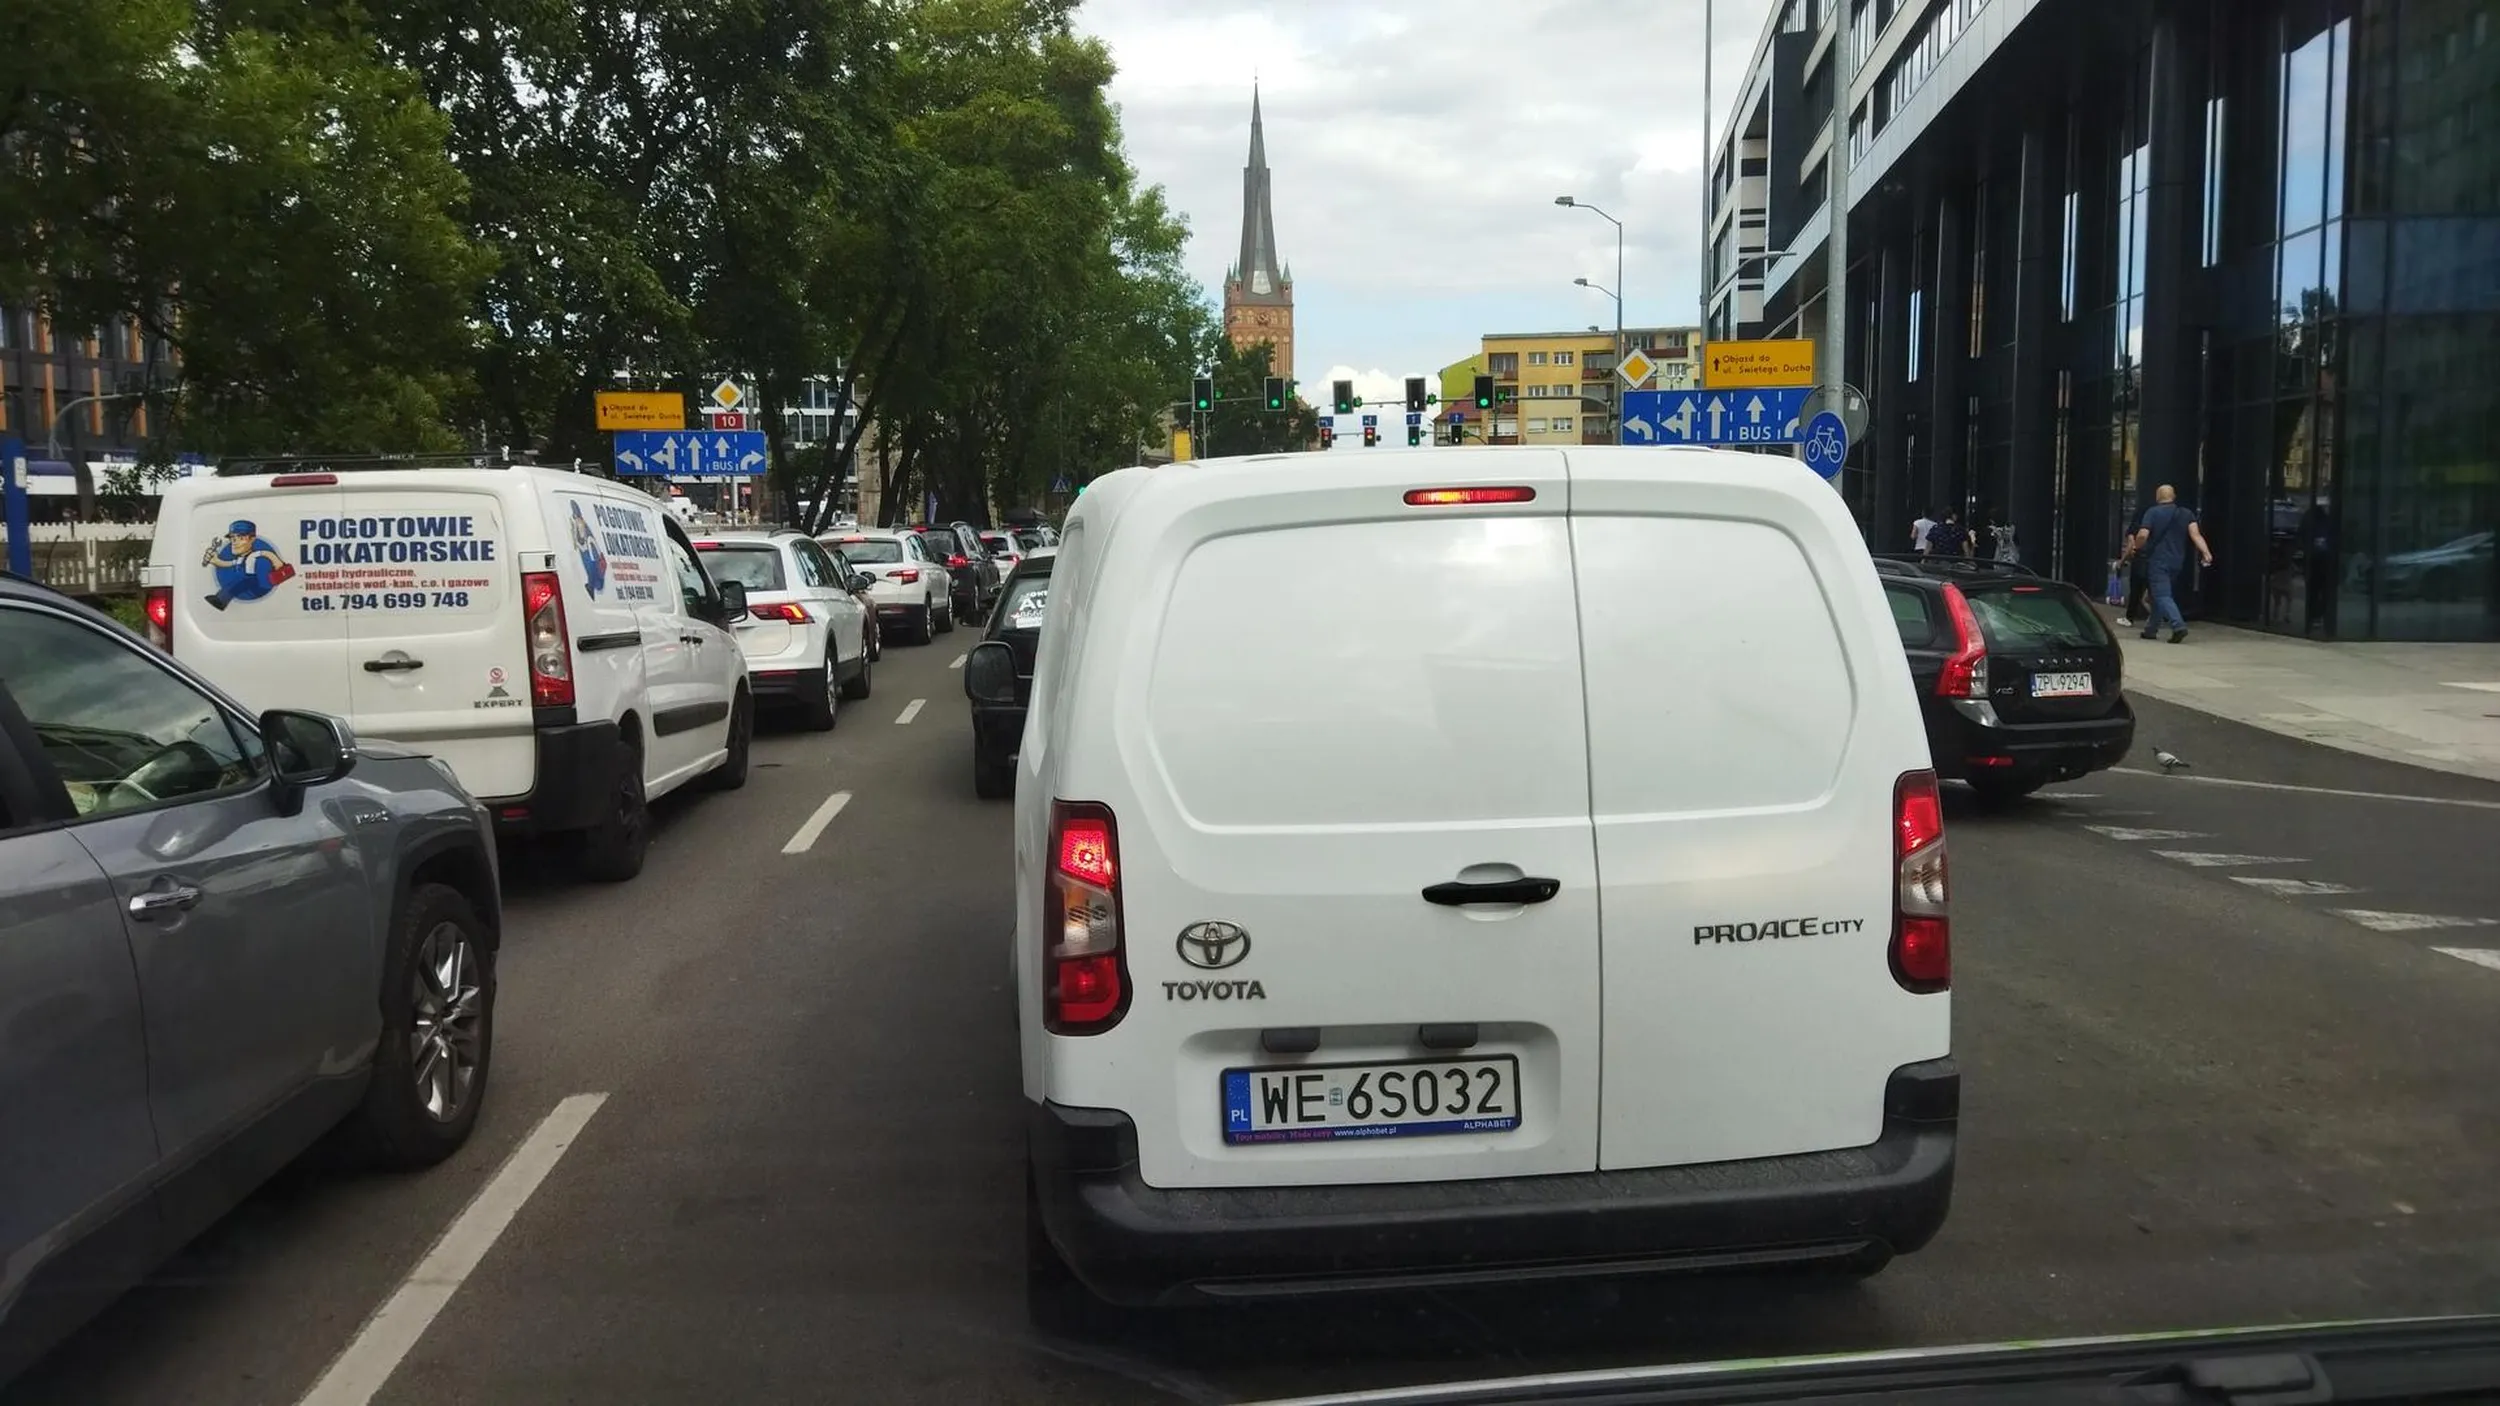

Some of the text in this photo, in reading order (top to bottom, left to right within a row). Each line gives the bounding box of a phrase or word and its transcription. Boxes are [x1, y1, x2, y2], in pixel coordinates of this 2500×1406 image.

[1759, 354, 1770, 362] do
[722, 415, 736, 427] 10
[1739, 426, 1771, 440] BUS
[713, 460, 734, 471] BUS
[300, 516, 473, 540] POGOTOWIE
[300, 540, 495, 565] LOKATORSKIE
[302, 592, 469, 611] tel. 794 699 748
[2037, 674, 2090, 691] ZPL 92947
[474, 699, 523, 708] EXPERT
[1694, 917, 1864, 945] PROACE CITY
[1162, 980, 1266, 1001] TOYOTA
[1261, 1067, 1502, 1124] WE 6S032
[1231, 1108, 1249, 1122] PL
[1464, 1119, 1512, 1129] ALPHABET
[1334, 1126, 1397, 1138] www.alphabet.pl
